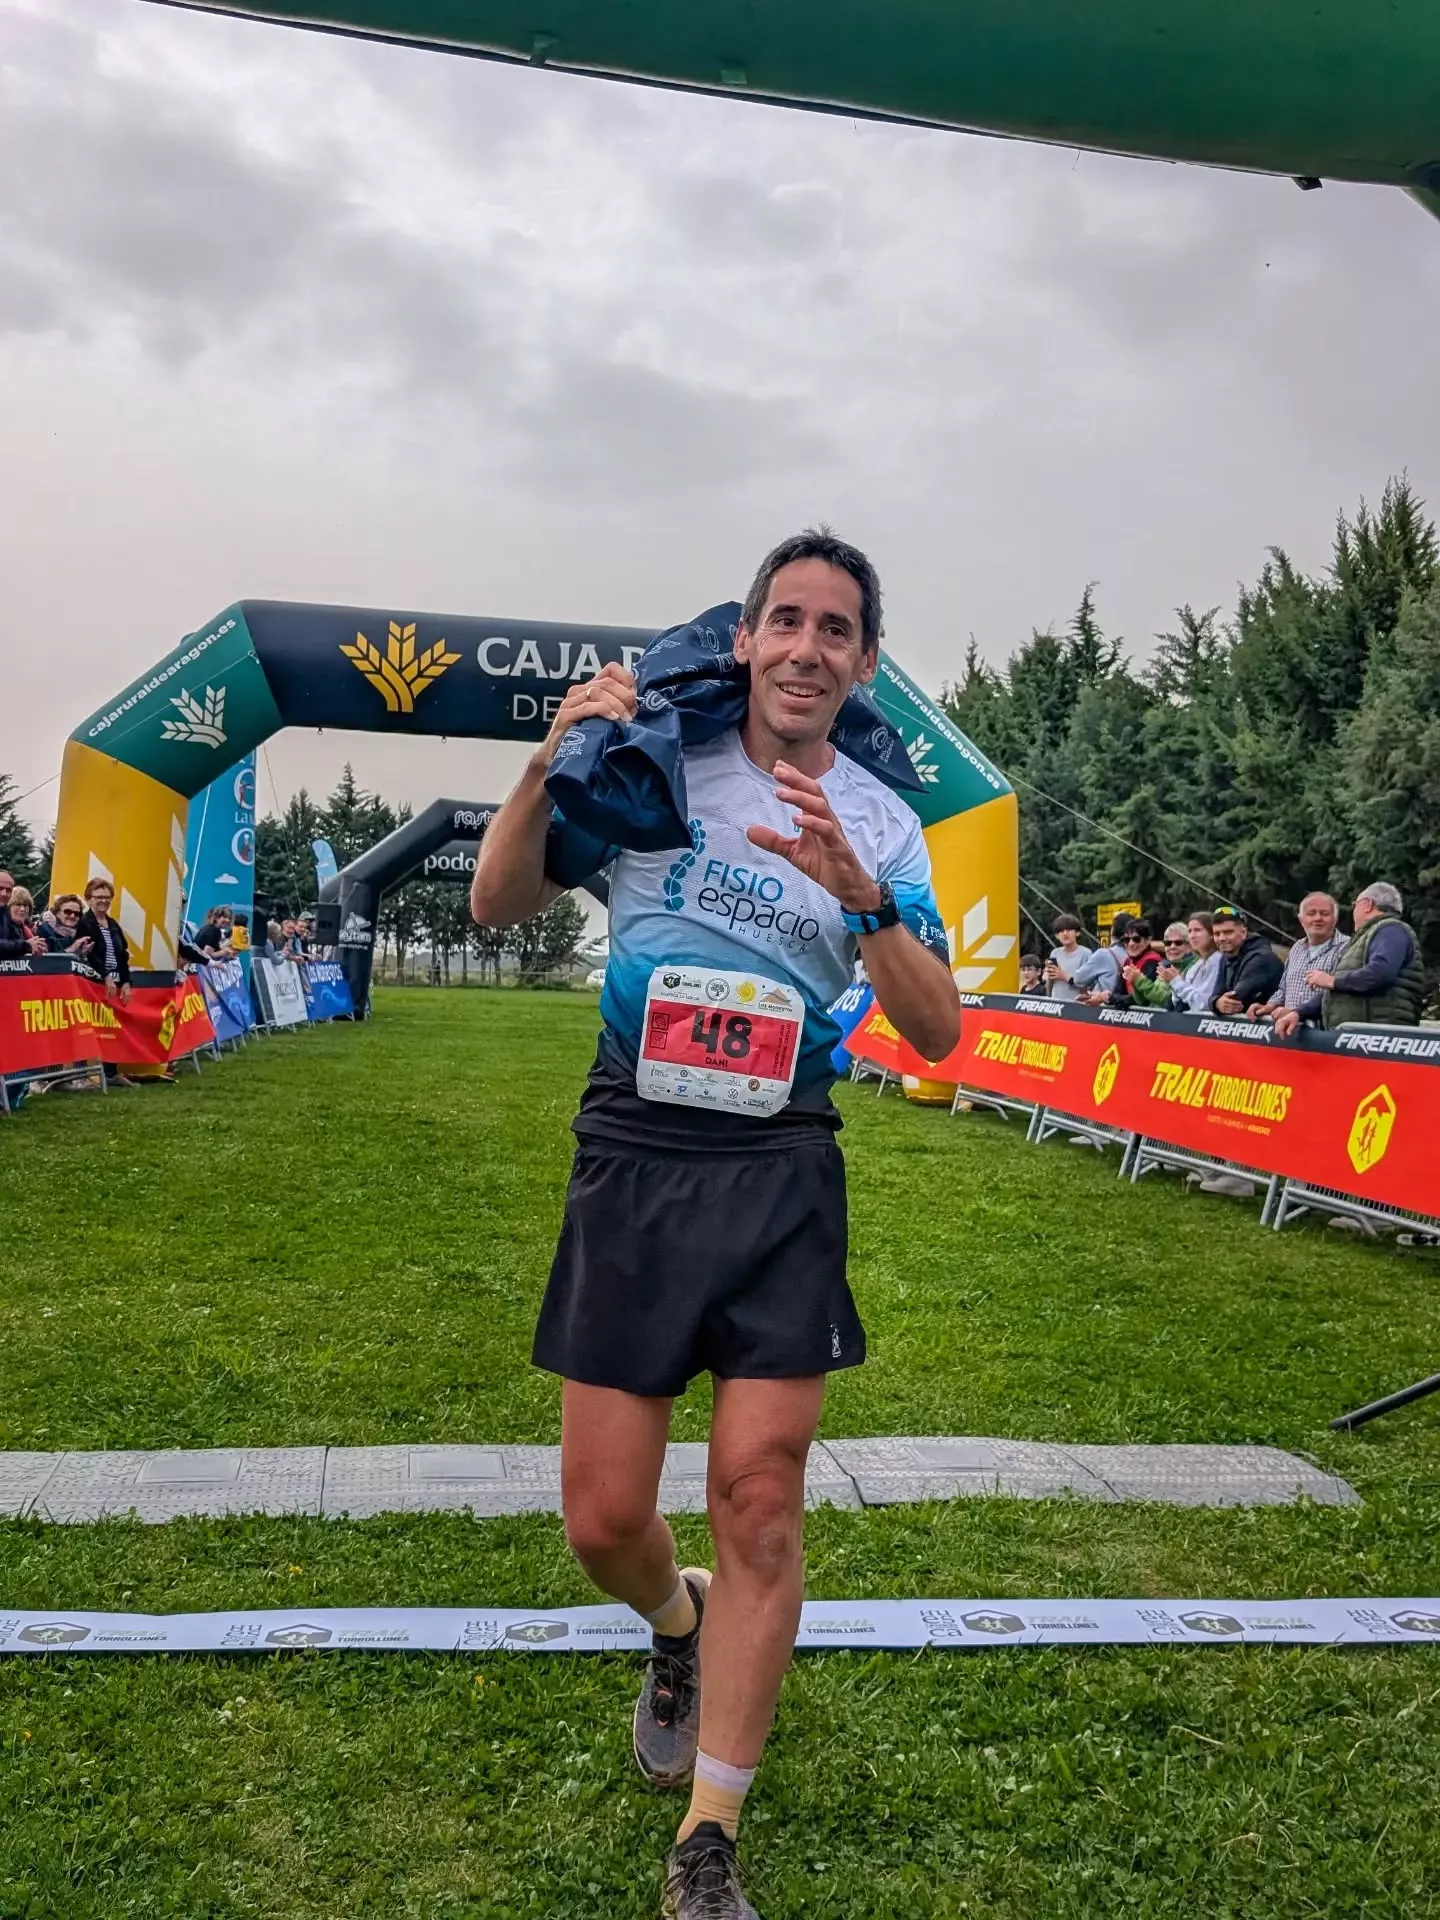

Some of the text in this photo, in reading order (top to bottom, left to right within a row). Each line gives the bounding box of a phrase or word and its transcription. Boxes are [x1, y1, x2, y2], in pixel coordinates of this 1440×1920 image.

[88, 619, 237, 737] cajaruraldearagon.es
[477, 637, 603, 680] CAJA
[880, 663, 1000, 790] cajaruraldearagon.es
[703, 859, 784, 902] FISIO
[698, 887, 820, 941] espacio
[738, 926, 806, 952] HUESCA
[1016, 1000, 1065, 1016] FIREHAWK
[1098, 1008, 1155, 1027] FIREHAWK
[691, 1010, 753, 1059] 48
[973, 1030, 1068, 1073] TRAIL TORROLLONES
[1197, 1019, 1274, 1043] FIREHAWK
[1150, 1061, 1293, 1122] TRAIL TORROLLONES
